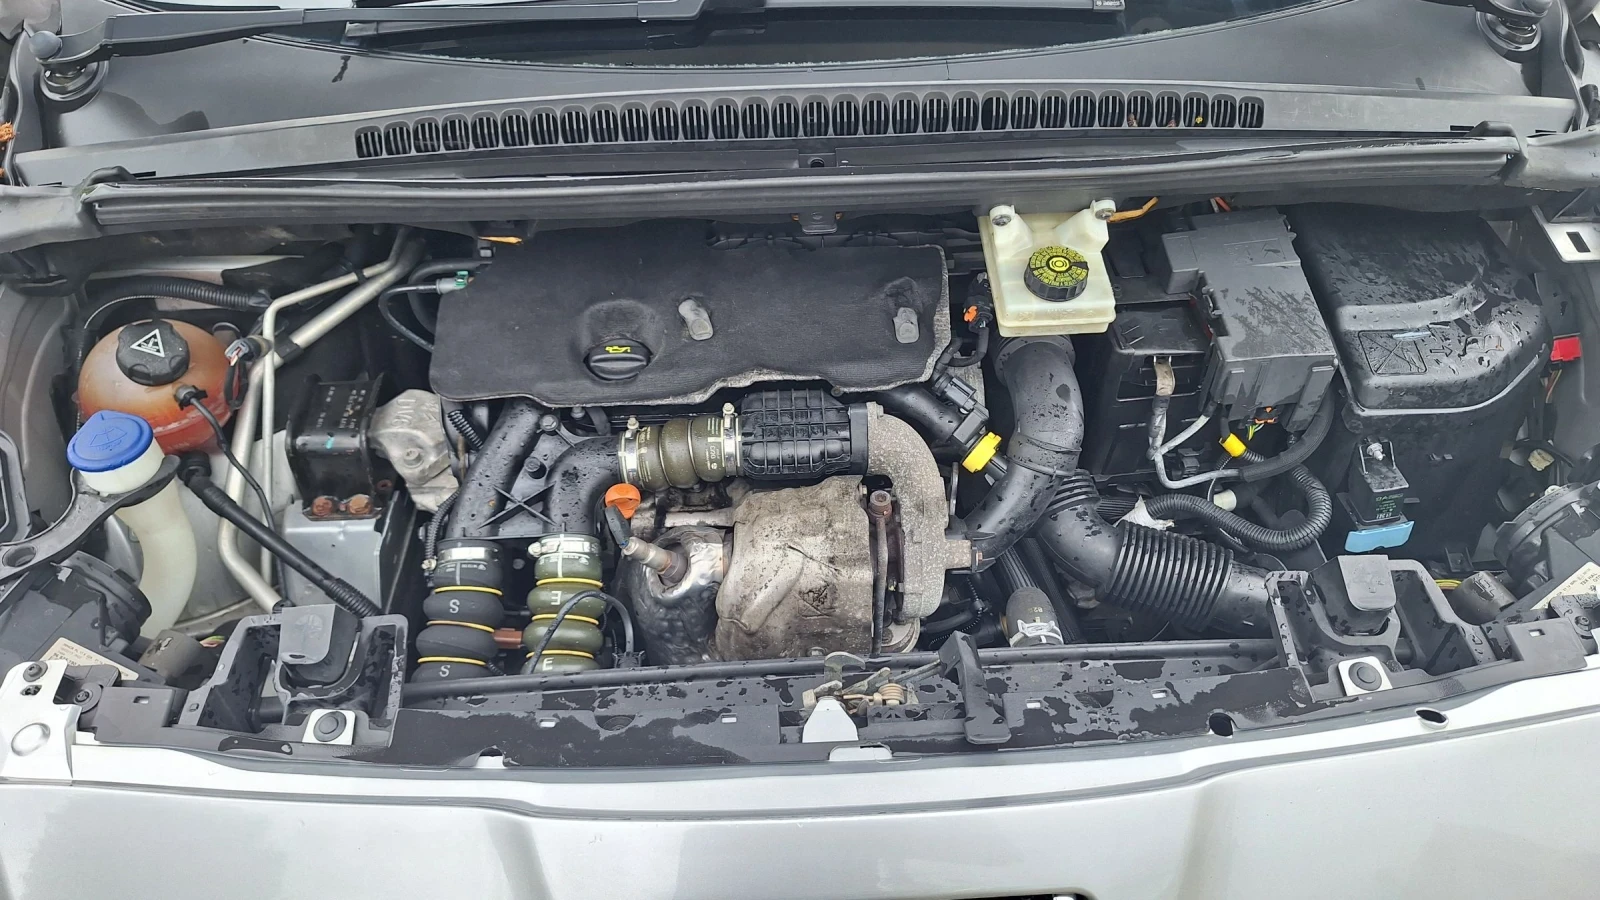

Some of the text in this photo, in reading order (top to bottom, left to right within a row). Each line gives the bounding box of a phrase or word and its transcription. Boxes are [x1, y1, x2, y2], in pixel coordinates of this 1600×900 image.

[550, 590, 562, 606] E
[449, 598, 460, 614] S
[438, 664, 451, 678] S
[542, 657, 555, 671] E
